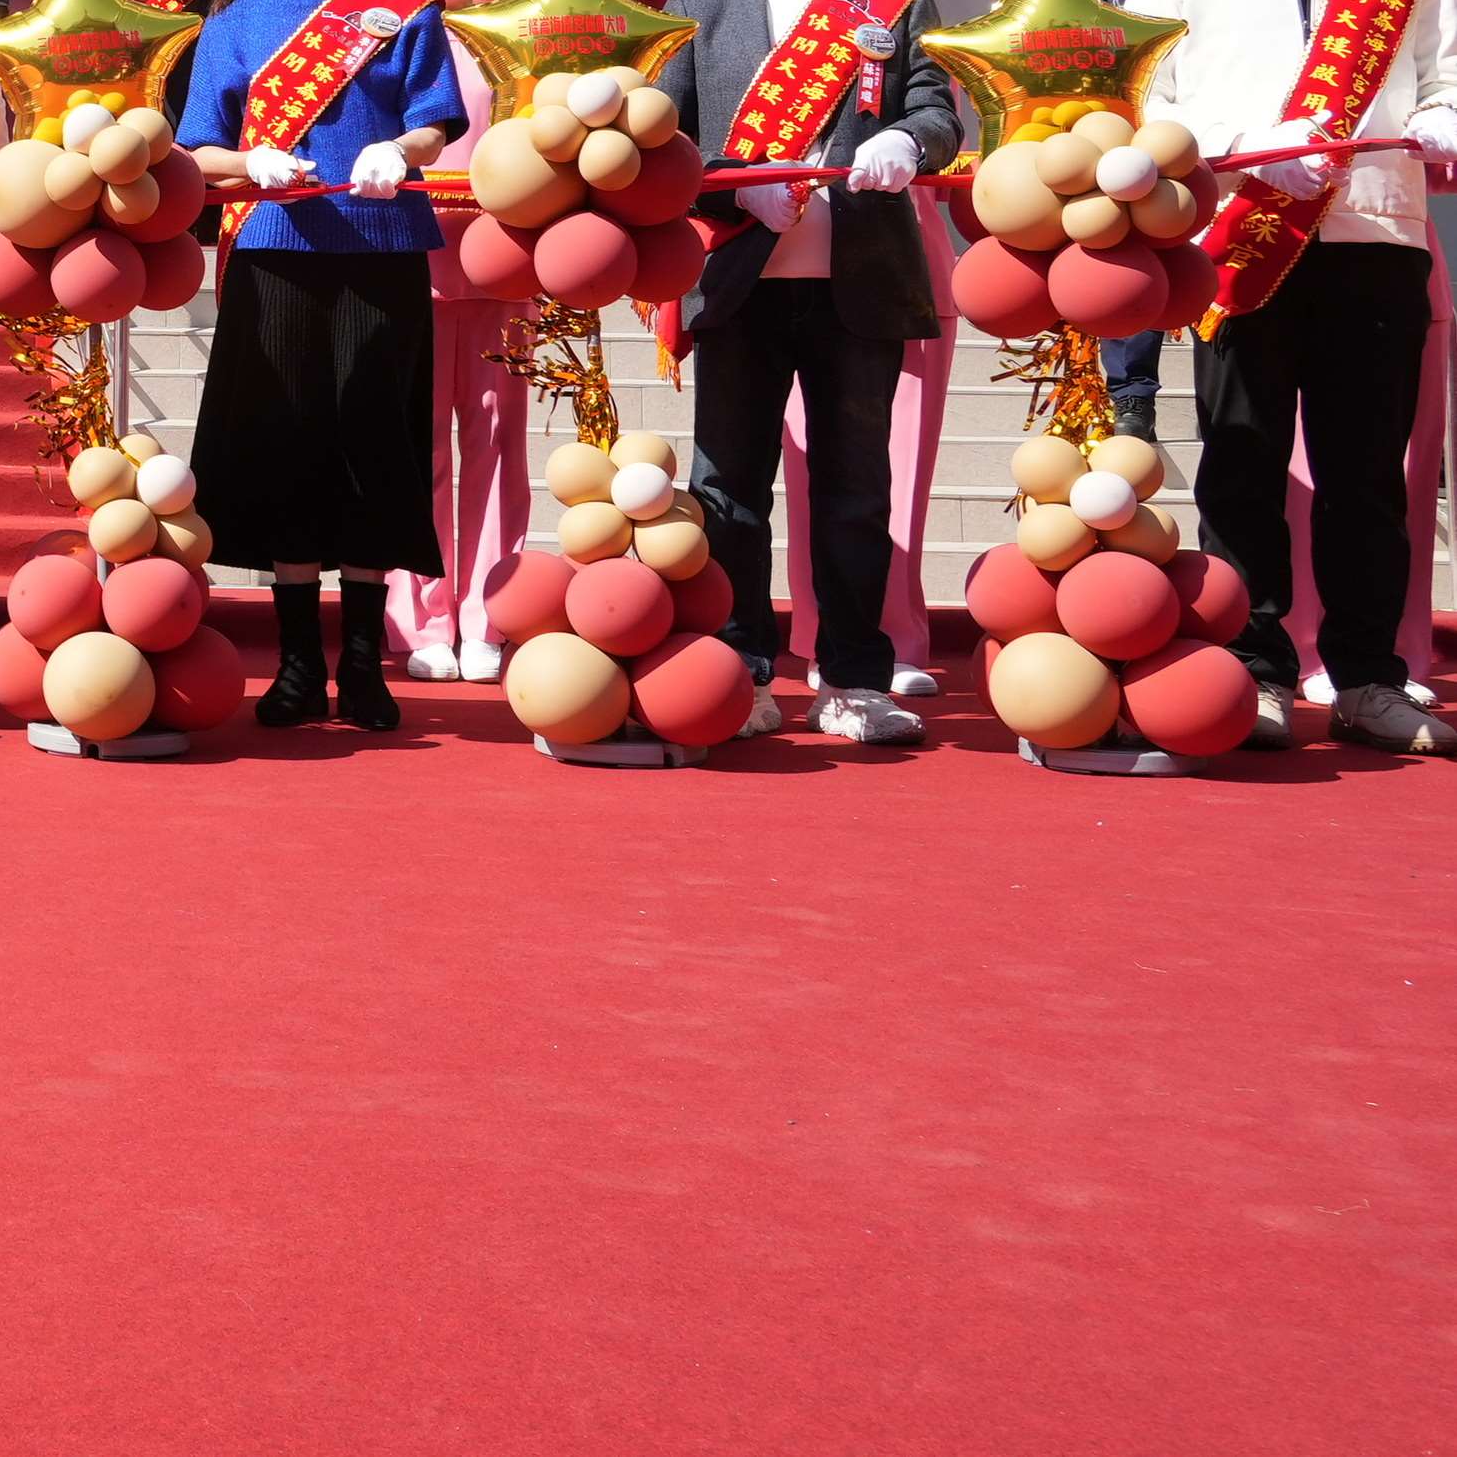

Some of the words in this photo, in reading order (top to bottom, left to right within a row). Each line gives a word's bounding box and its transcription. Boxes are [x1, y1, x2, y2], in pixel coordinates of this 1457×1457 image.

[734, 13, 831, 160] 休閒大樓啟用
